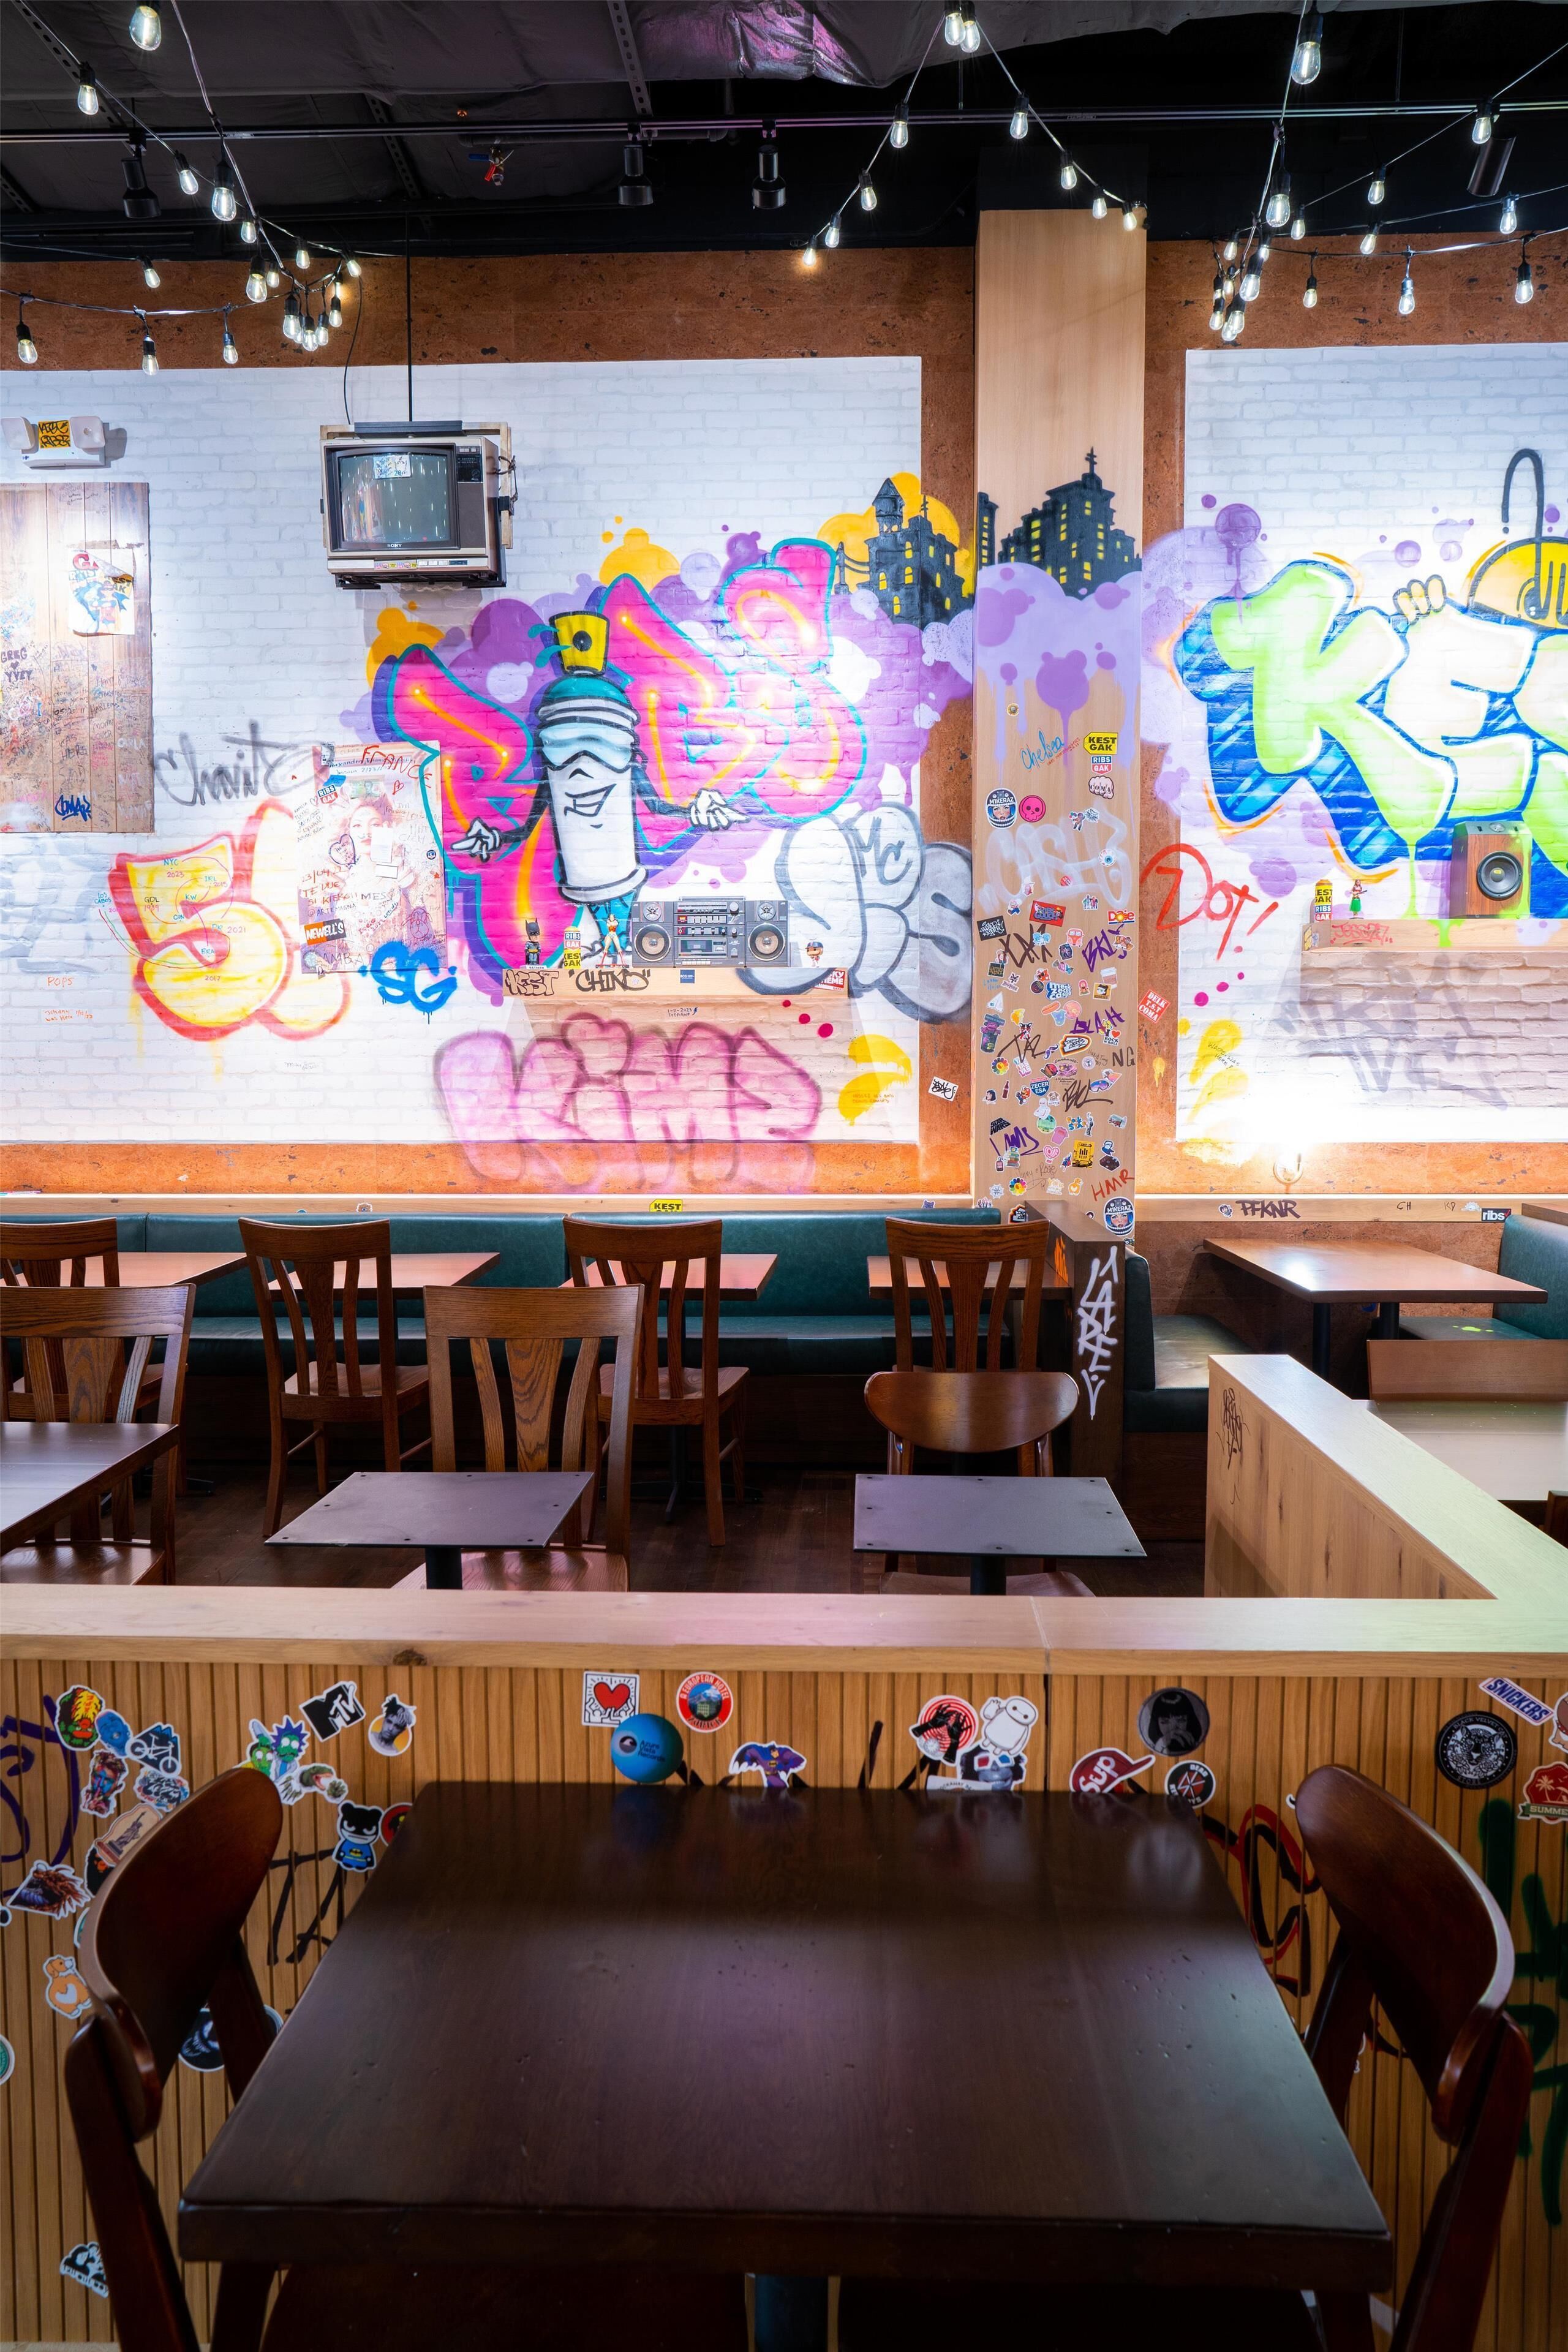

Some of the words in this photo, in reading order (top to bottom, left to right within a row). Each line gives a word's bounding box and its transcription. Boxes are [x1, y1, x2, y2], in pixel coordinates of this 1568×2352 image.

[1, 647, 28, 663] GREG
[1020, 729, 1064, 769] Chelsea
[318, 785, 336, 797] RIBS
[1090, 783, 1111, 794] COMA
[306, 922, 344, 940] NEWELL'S
[1147, 991, 1167, 1008] DELK
[1139, 1005, 1158, 1022] COMA
[990, 1122, 1011, 1136] WARS
[991, 1117, 1006, 1126] STAR
[1091, 1169, 1135, 1202] HMR
[1482, 1210, 1506, 1221] ribs
[682, 1674, 715, 1694] EUROPEAN
[714, 1679, 730, 1700] HOTEL
[1487, 1679, 1550, 1722] SNICKERS
[301, 1683, 364, 1741] MTV
[1453, 1717, 1475, 1730] BLACK
[1475, 1716, 1499, 1729] VELVET
[1497, 1726, 1509, 1740] CAT
[639, 1740, 660, 1750] Azure
[638, 1751, 666, 1763] Records
[1189, 1763, 1208, 1777] DEAD
